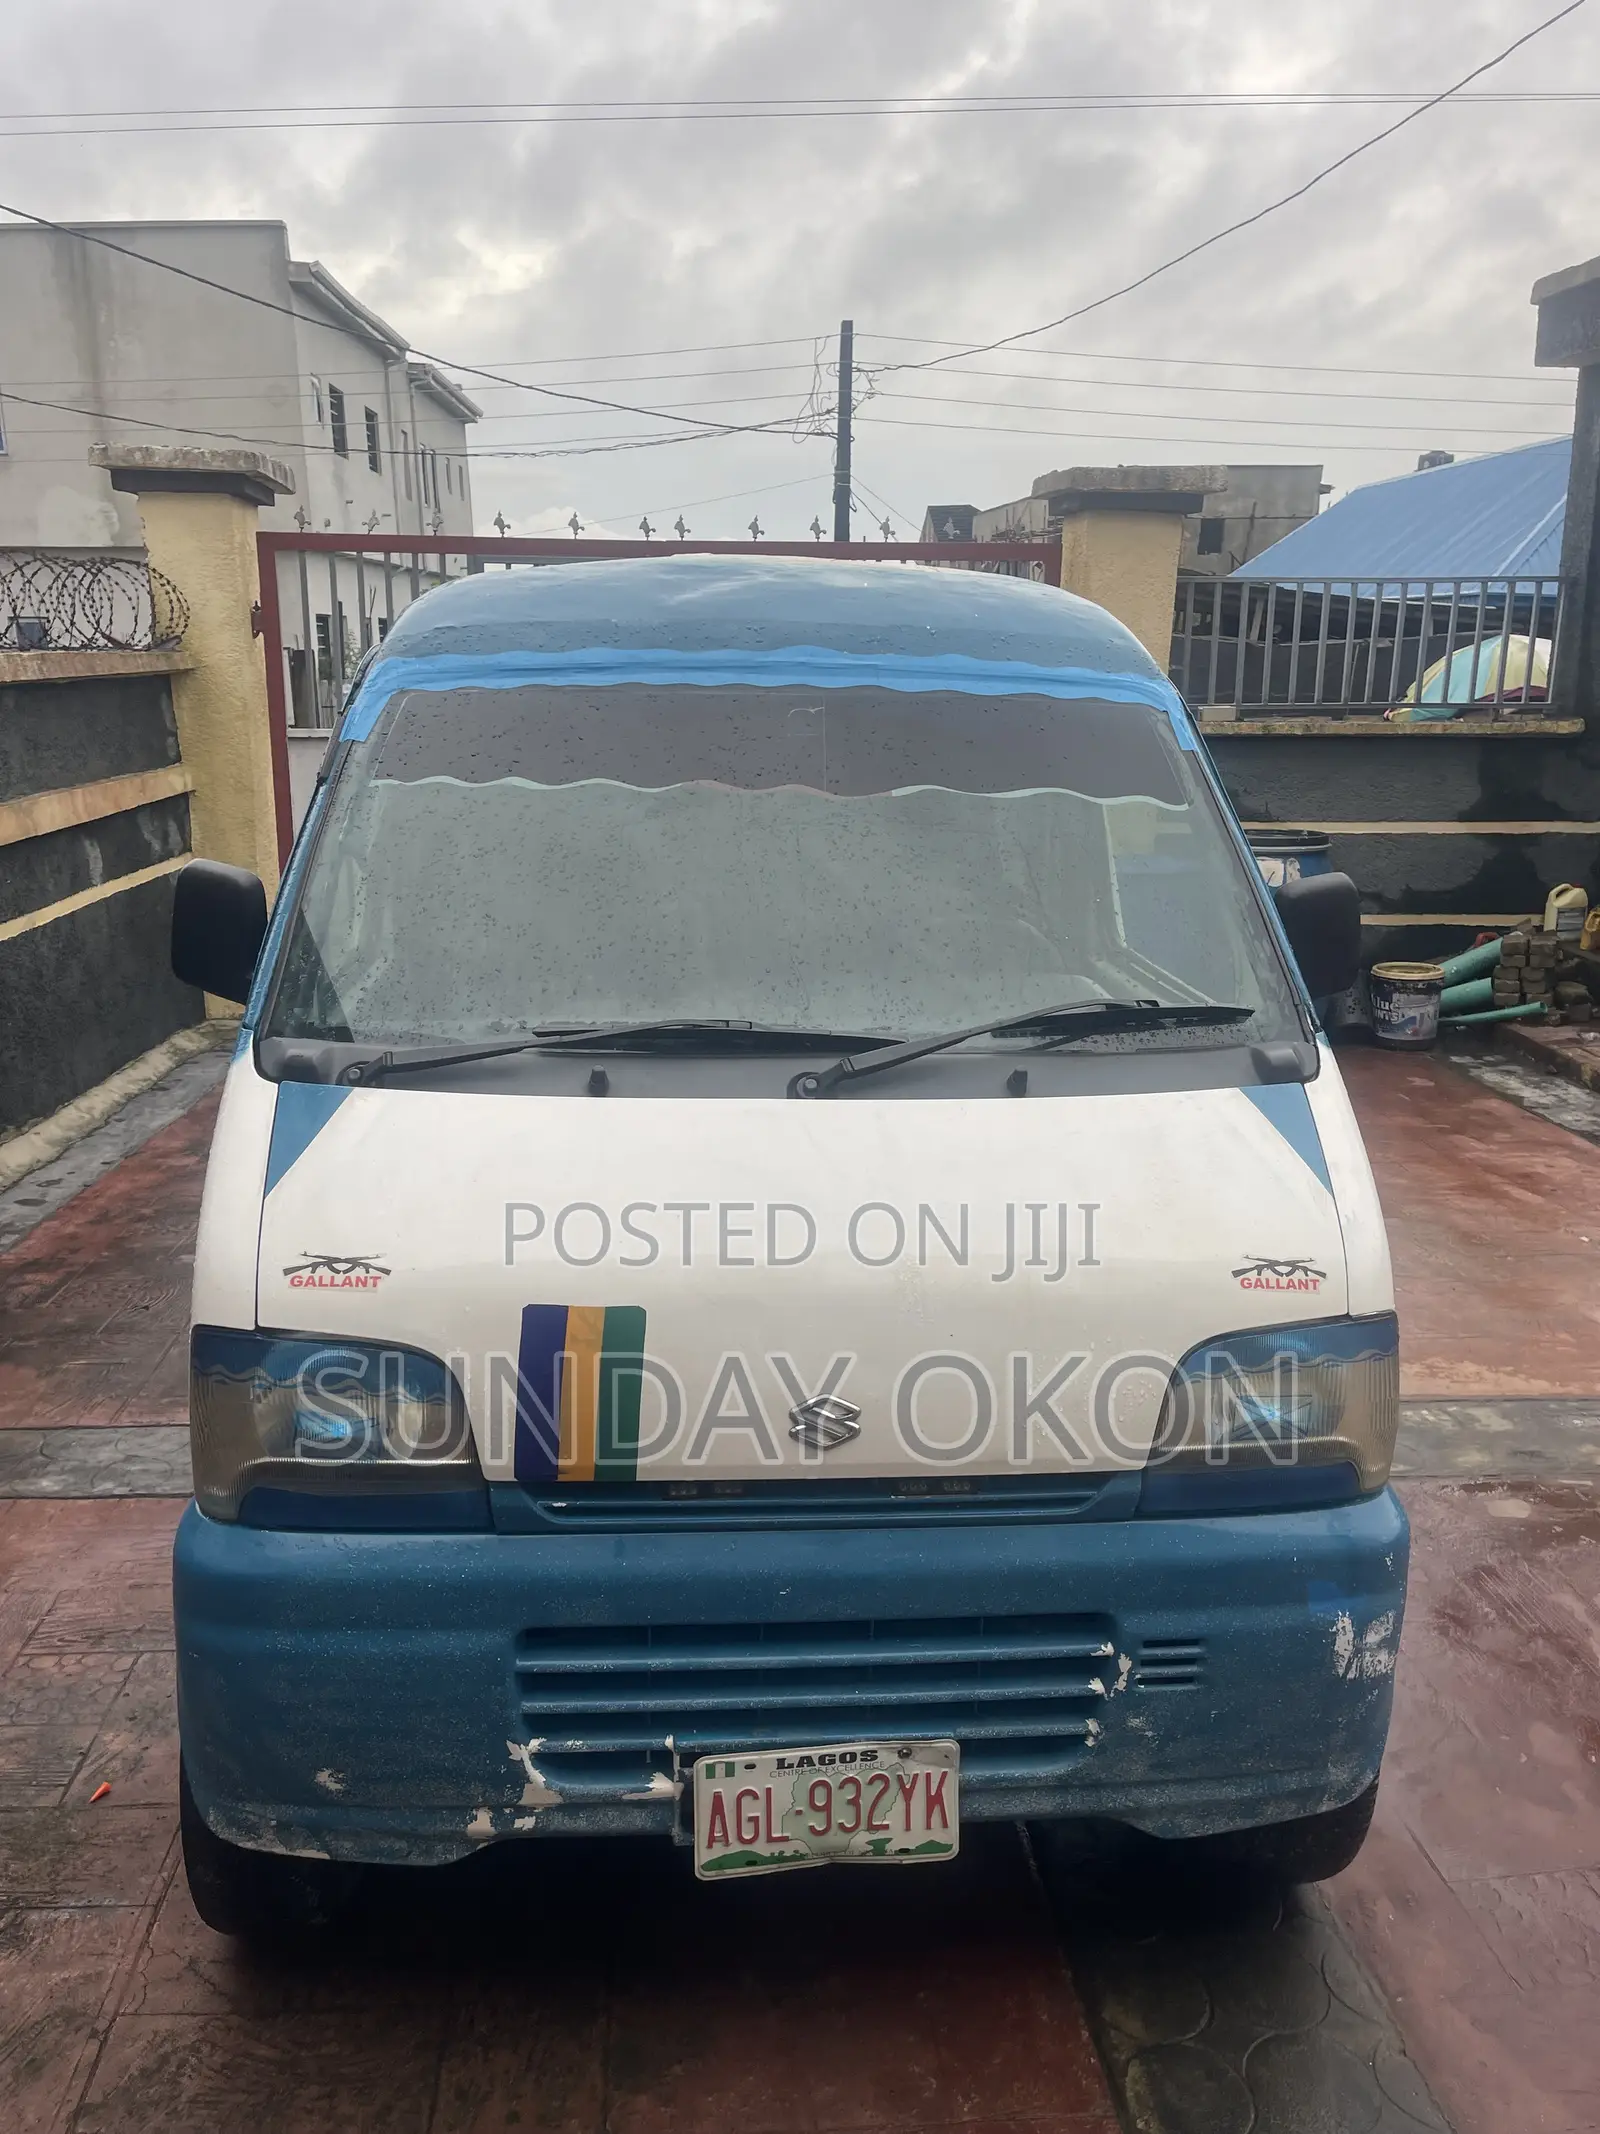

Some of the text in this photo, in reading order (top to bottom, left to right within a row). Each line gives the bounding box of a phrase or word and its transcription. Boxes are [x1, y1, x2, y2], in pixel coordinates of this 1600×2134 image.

[289, 1273, 382, 1290] GALLANT
[1239, 1276, 1320, 1291] GALLANT
[776, 1750, 879, 1770] LAGOS
[769, 1767, 806, 1778] CENTRE
[825, 1761, 885, 1774] EXCELLENCE
